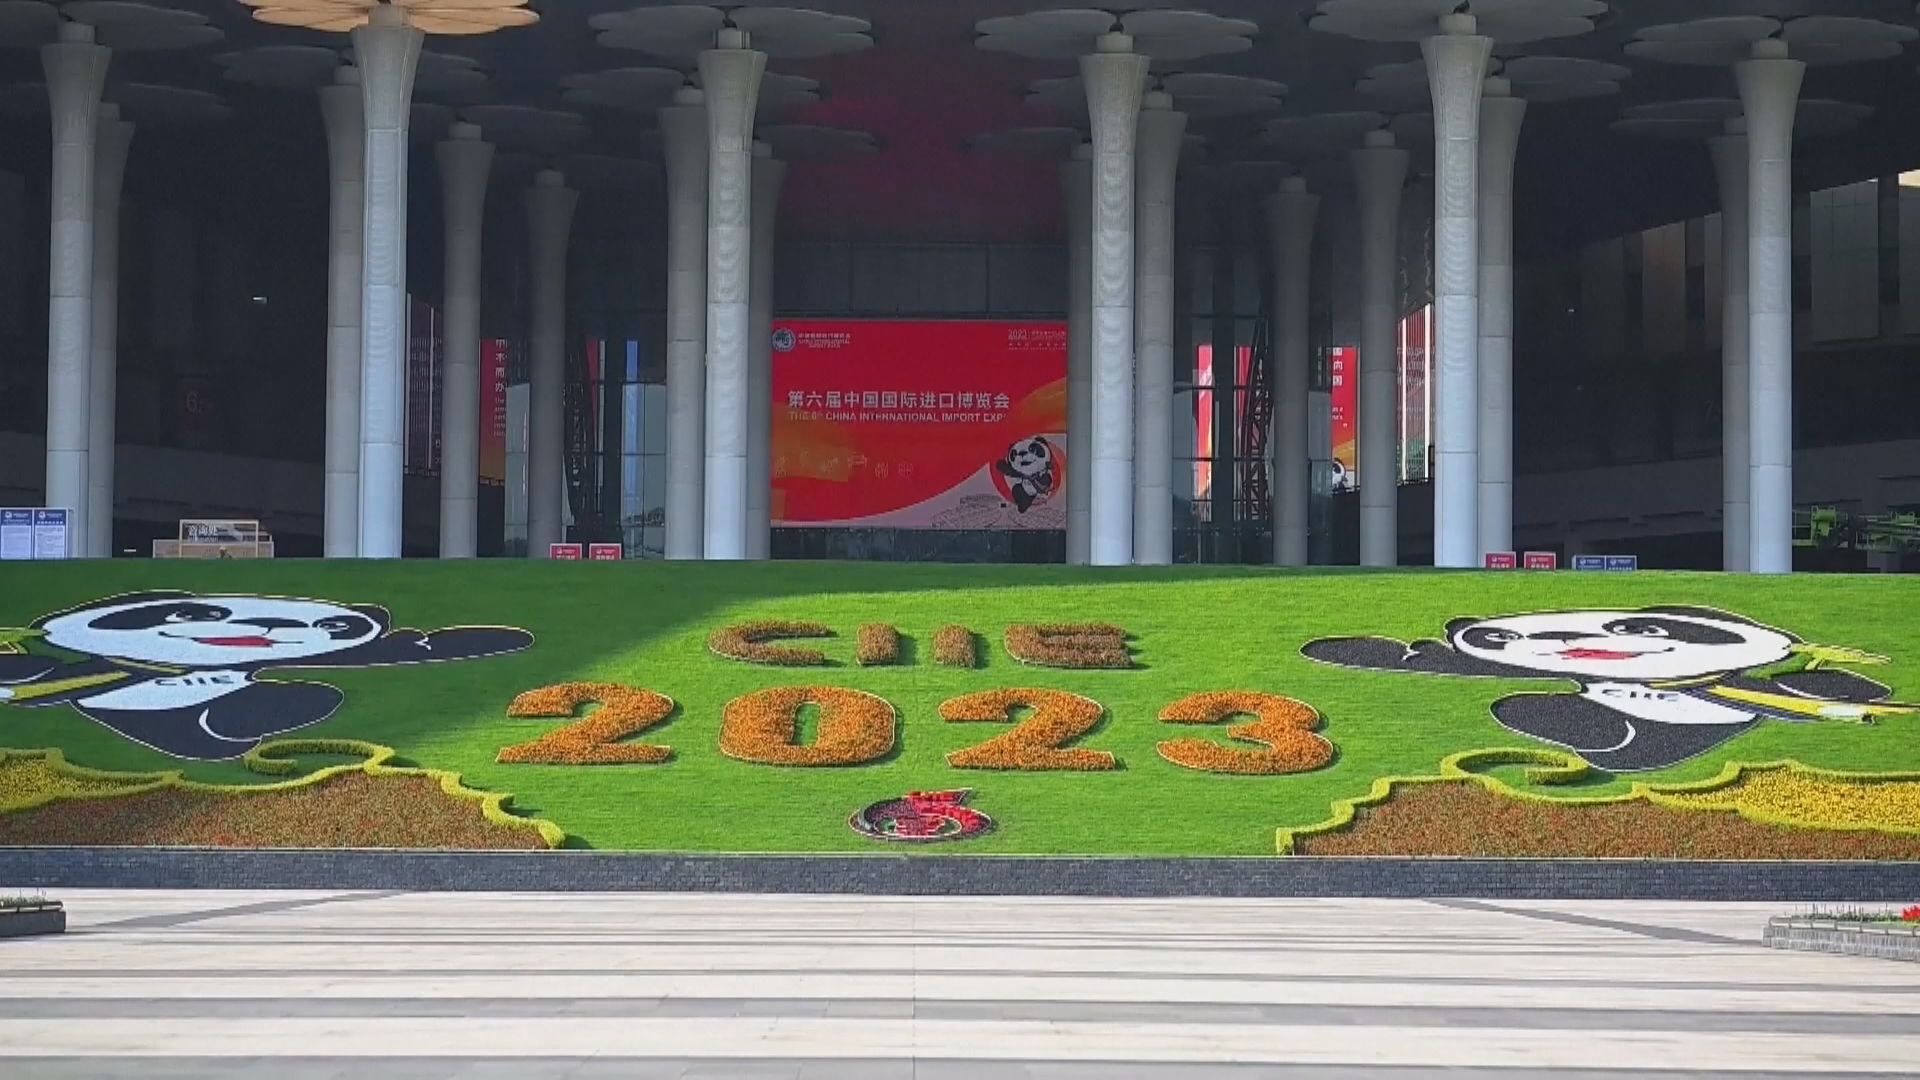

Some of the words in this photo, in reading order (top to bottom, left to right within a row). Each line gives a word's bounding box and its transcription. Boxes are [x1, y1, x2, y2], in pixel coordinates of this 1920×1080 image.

[788, 391, 1010, 409] 第六届中国国际进口博览会
[825, 411, 857, 422] CHINA
[859, 412, 939, 422] INTERNATIONAL
[941, 412, 981, 423] IMPORT
[707, 618, 1136, 669] CIIE
[155, 675, 234, 686] CIIE
[1602, 688, 1679, 702] CIIE
[495, 682, 1334, 775] 2023
